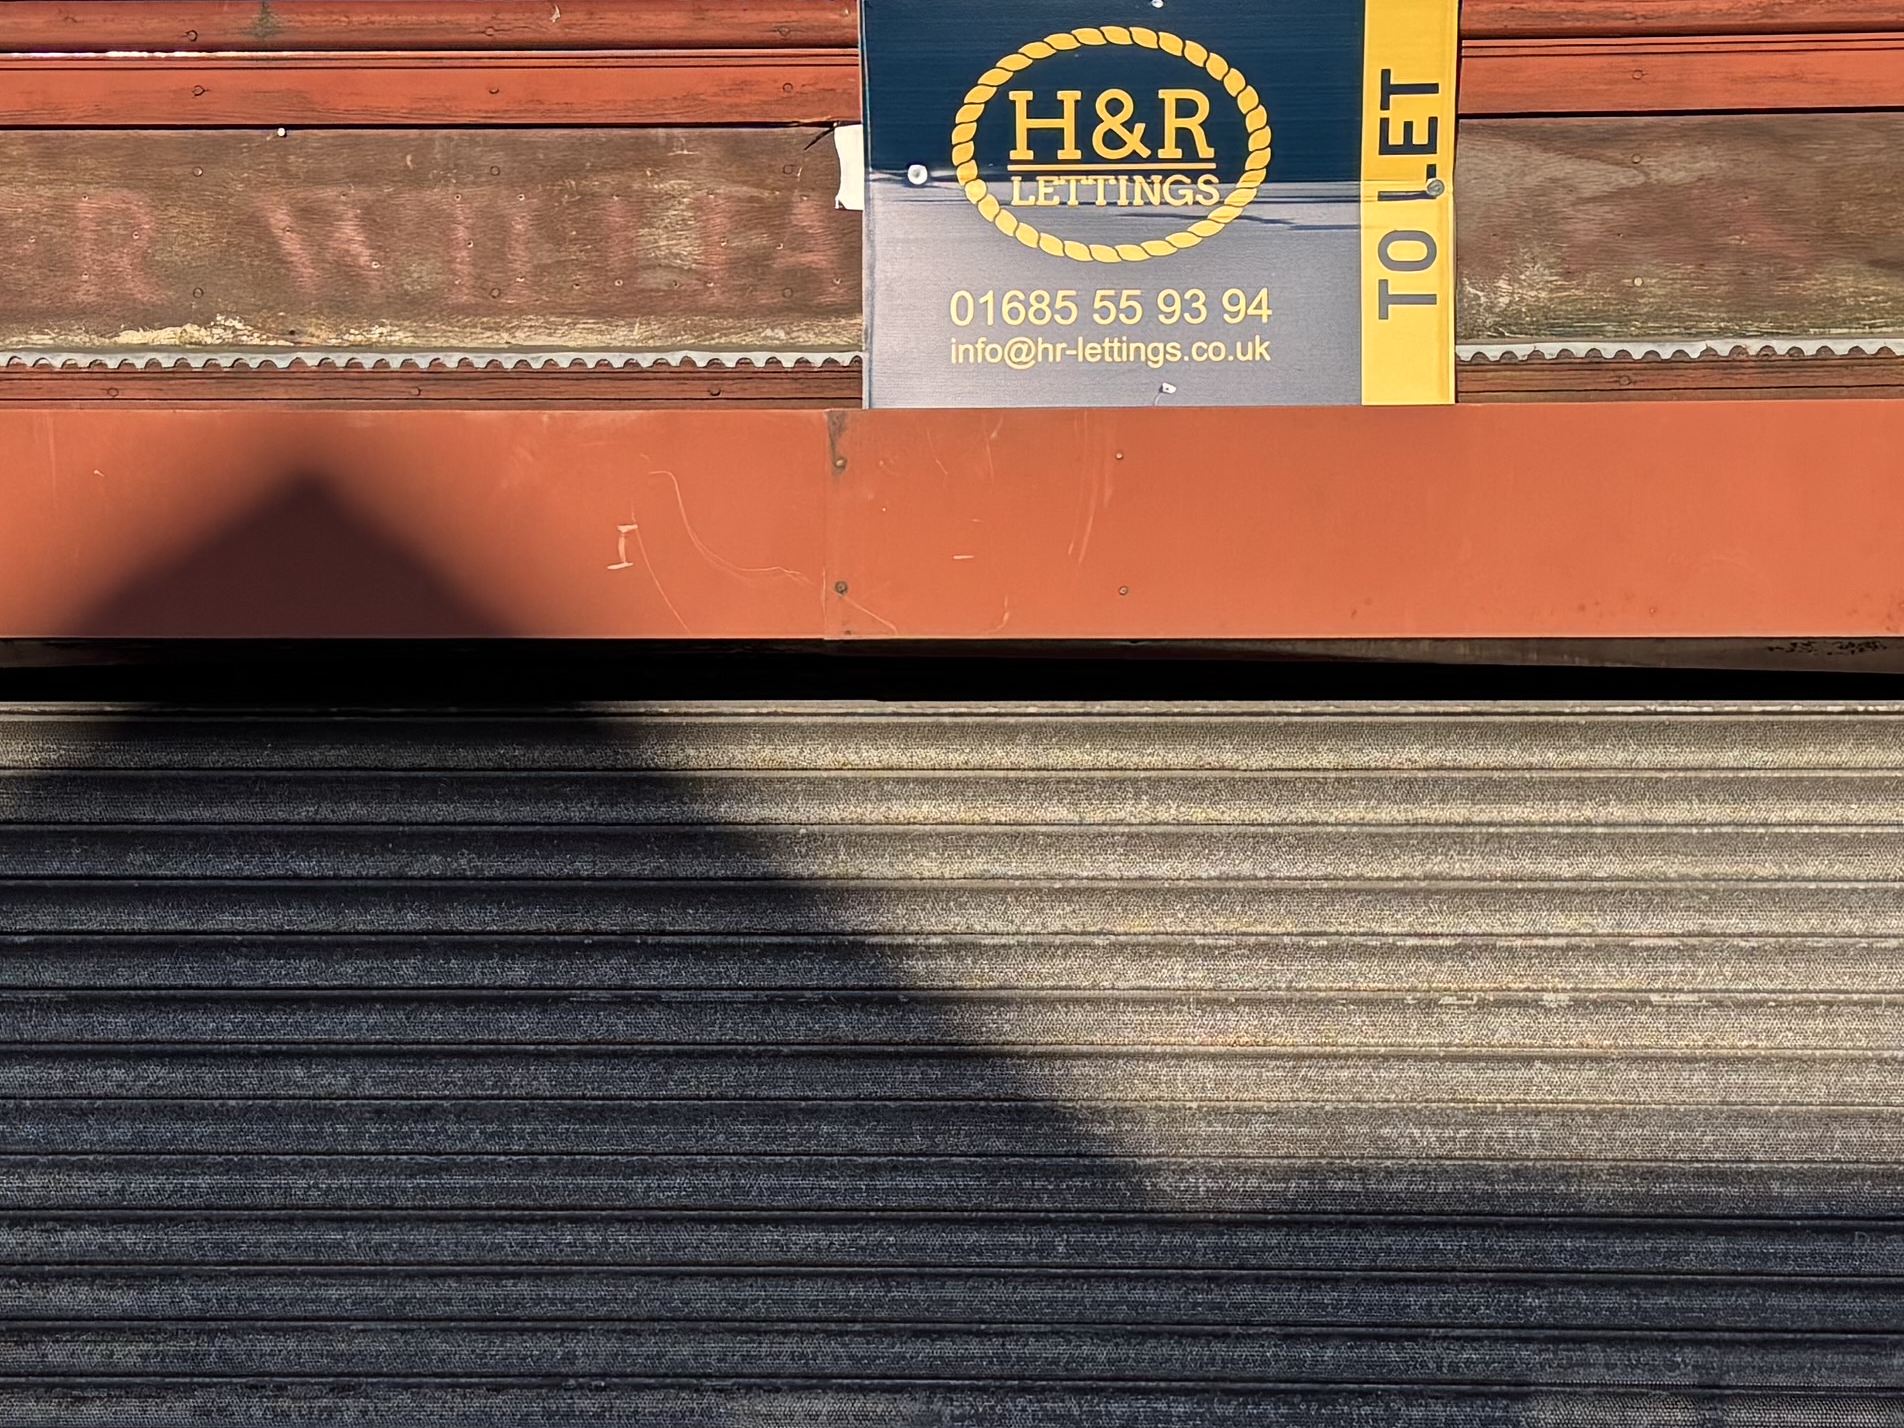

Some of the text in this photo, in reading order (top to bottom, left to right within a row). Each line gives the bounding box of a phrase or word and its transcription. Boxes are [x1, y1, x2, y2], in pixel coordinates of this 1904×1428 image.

[1008, 88, 1215, 160] H&R
[1010, 174, 1220, 206] LETTINGS
[1377, 68, 1440, 320] TO LET
[949, 287, 1272, 326] 01685 55 93 94
[950, 335, 1271, 369] info@hr-lettings.co.uk
